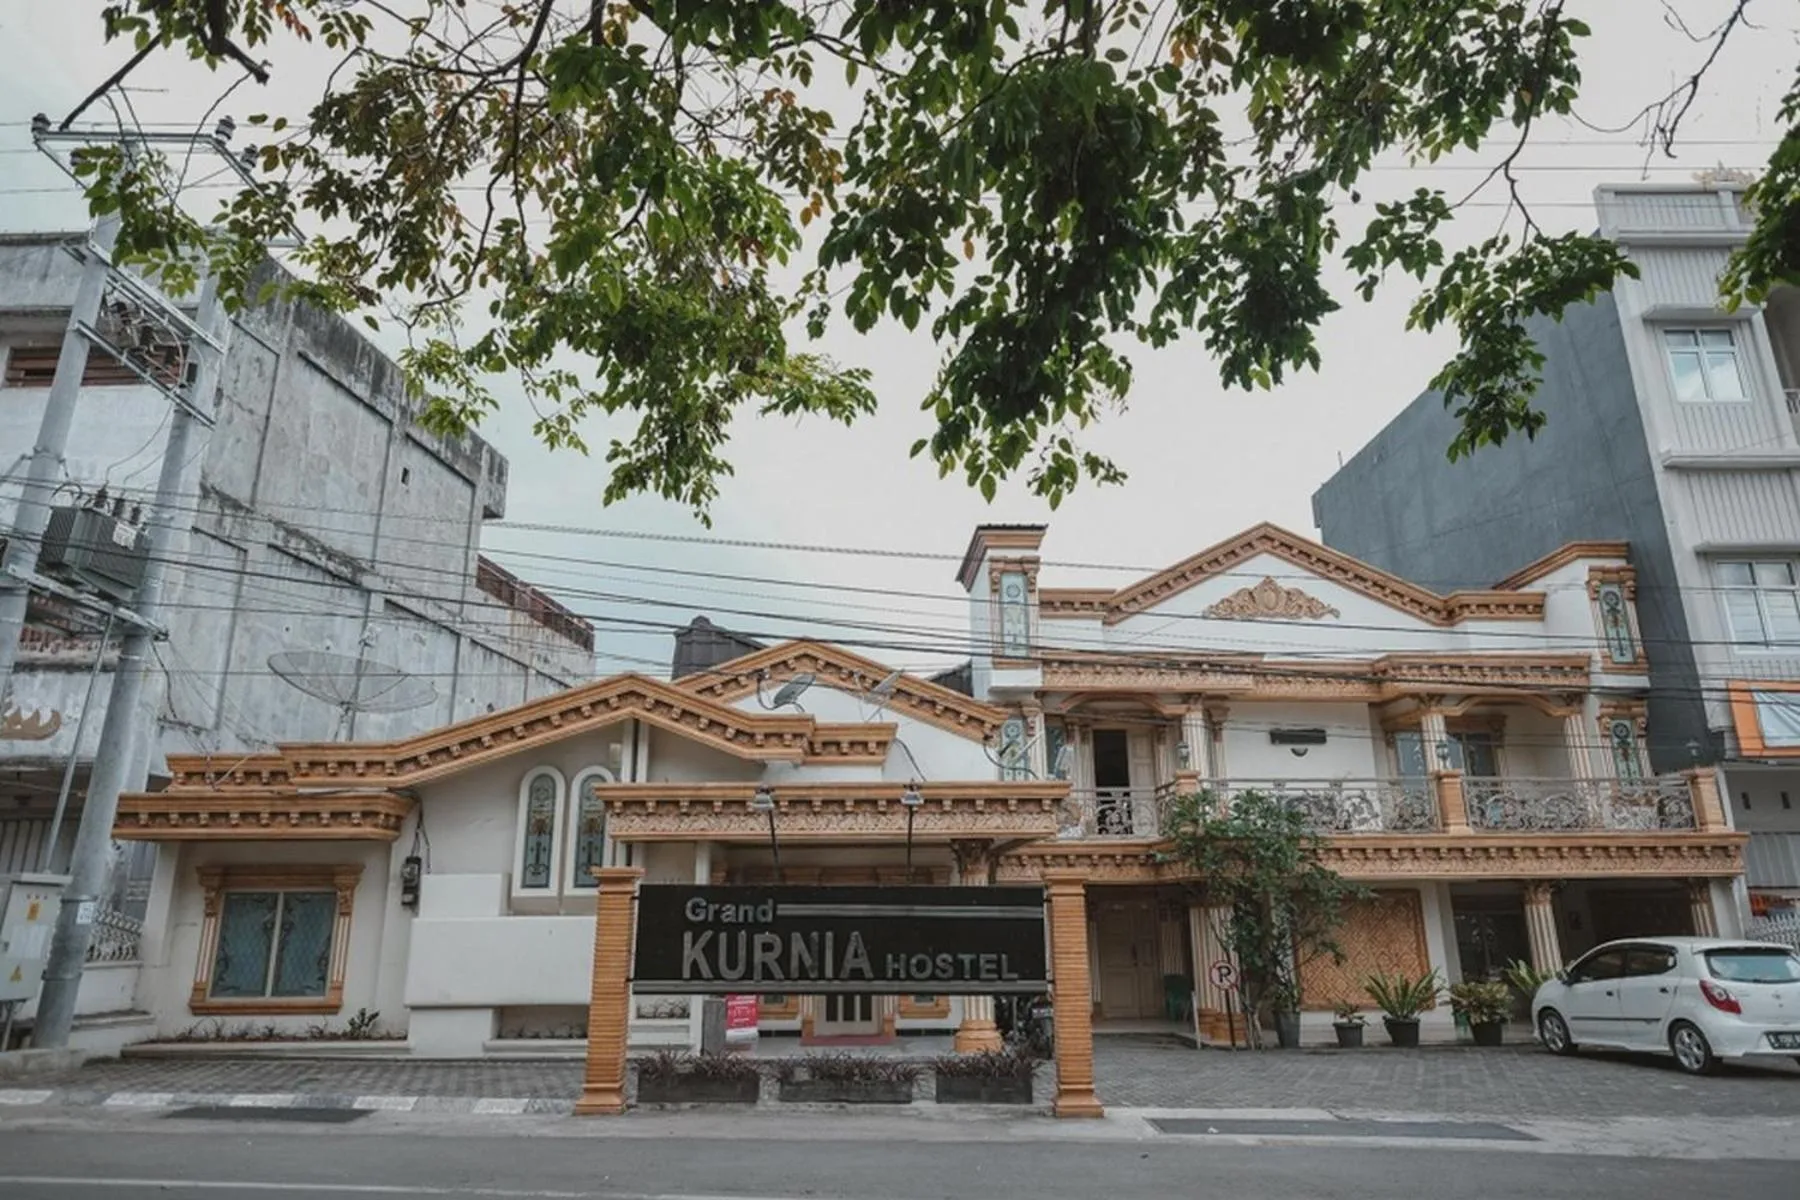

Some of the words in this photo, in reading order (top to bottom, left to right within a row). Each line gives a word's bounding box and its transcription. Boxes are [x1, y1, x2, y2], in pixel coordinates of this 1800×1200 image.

[685, 897, 774, 922] Grand
[682, 929, 874, 980] KURNIA
[885, 953, 1019, 979] HOSTEL
